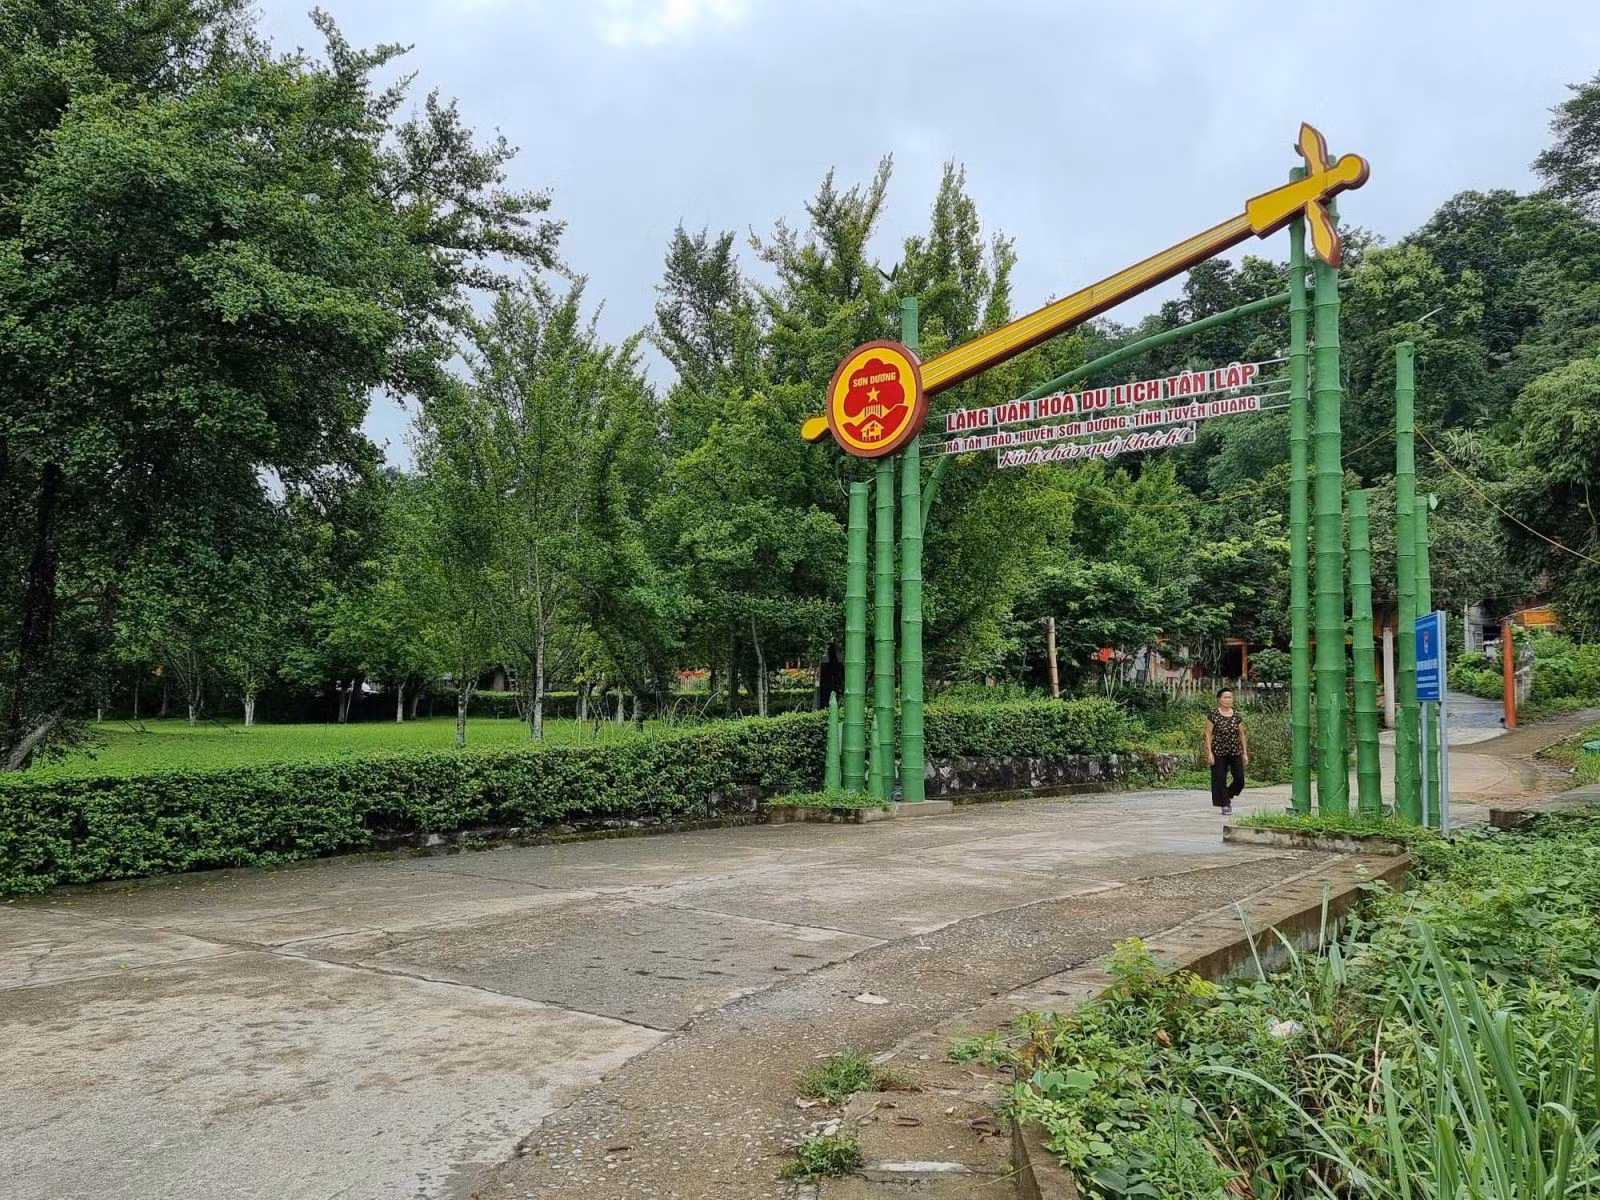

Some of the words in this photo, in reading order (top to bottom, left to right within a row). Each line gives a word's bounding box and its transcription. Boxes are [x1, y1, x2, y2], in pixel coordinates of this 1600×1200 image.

[853, 377, 869, 388] SƠN
[946, 409, 990, 431] LÀNG
[996, 400, 1031, 423] VĂN
[1038, 393, 1074, 417] HÓA
[1082, 389, 1108, 410] DU
[1115, 380, 1160, 407] LỊCH
[1167, 370, 1206, 396] TÂN
[1215, 362, 1256, 392] LẬP
[946, 438, 960, 452] XÃ
[963, 436, 982, 450] TÂN
[1019, 425, 1055, 443] HUYỆN
[1059, 422, 1081, 437] SƠN
[1134, 409, 1162, 426] TỈNH
[1167, 403, 1206, 420] TUYÊN
[1211, 397, 1257, 415] QUANG
[1001, 445, 1041, 467] Kính
[1042, 443, 1082, 462] chào
[1086, 437, 1120, 460] quý
[1123, 427, 1185, 450] khách!
